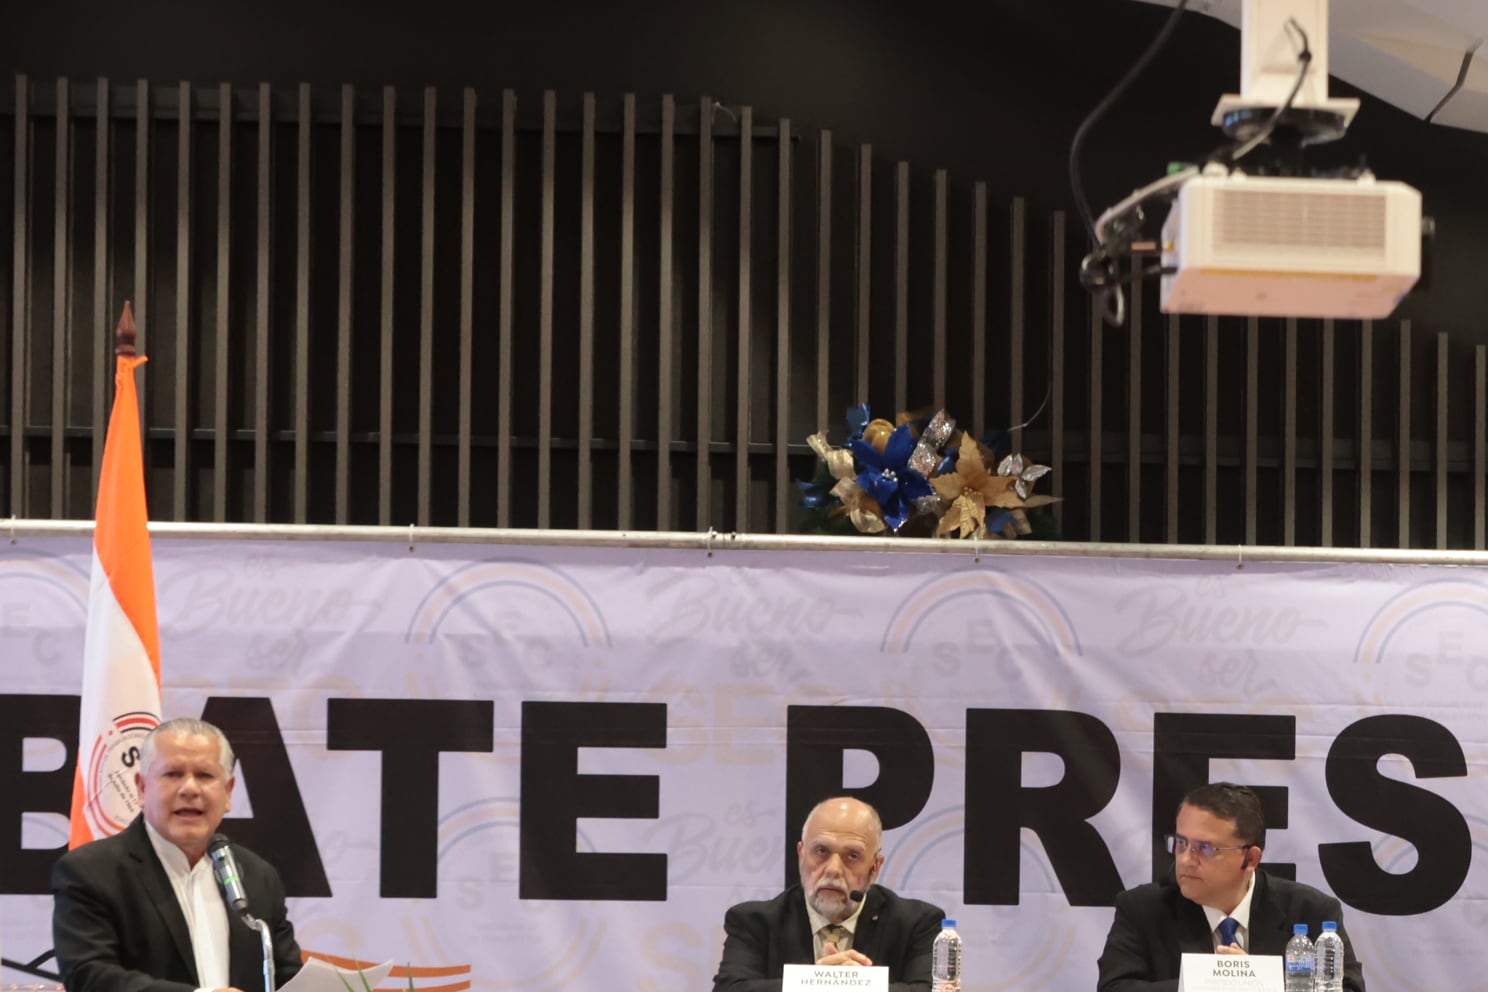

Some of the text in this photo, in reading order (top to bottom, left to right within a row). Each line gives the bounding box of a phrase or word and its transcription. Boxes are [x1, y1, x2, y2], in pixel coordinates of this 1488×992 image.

[1217, 960, 1251, 969] BORIS
[814, 970, 860, 979] WALTER
[1212, 969, 1256, 978] MOLINA
